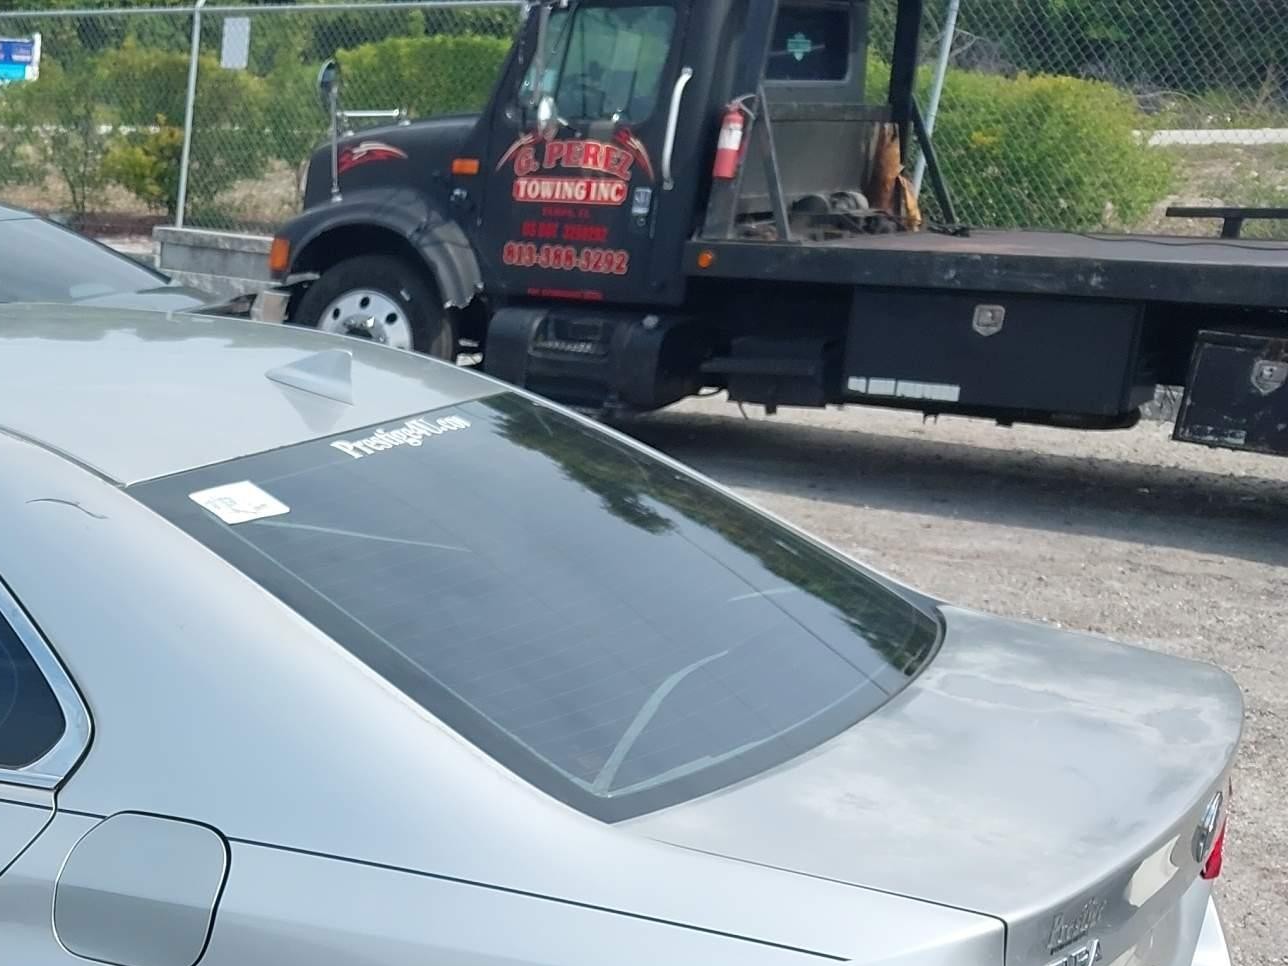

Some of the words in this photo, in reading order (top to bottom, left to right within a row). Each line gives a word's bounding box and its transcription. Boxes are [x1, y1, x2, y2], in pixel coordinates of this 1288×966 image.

[542, 140, 634, 180] PEREZ
[518, 180, 587, 201] TOWING
[589, 183, 625, 202] INC
